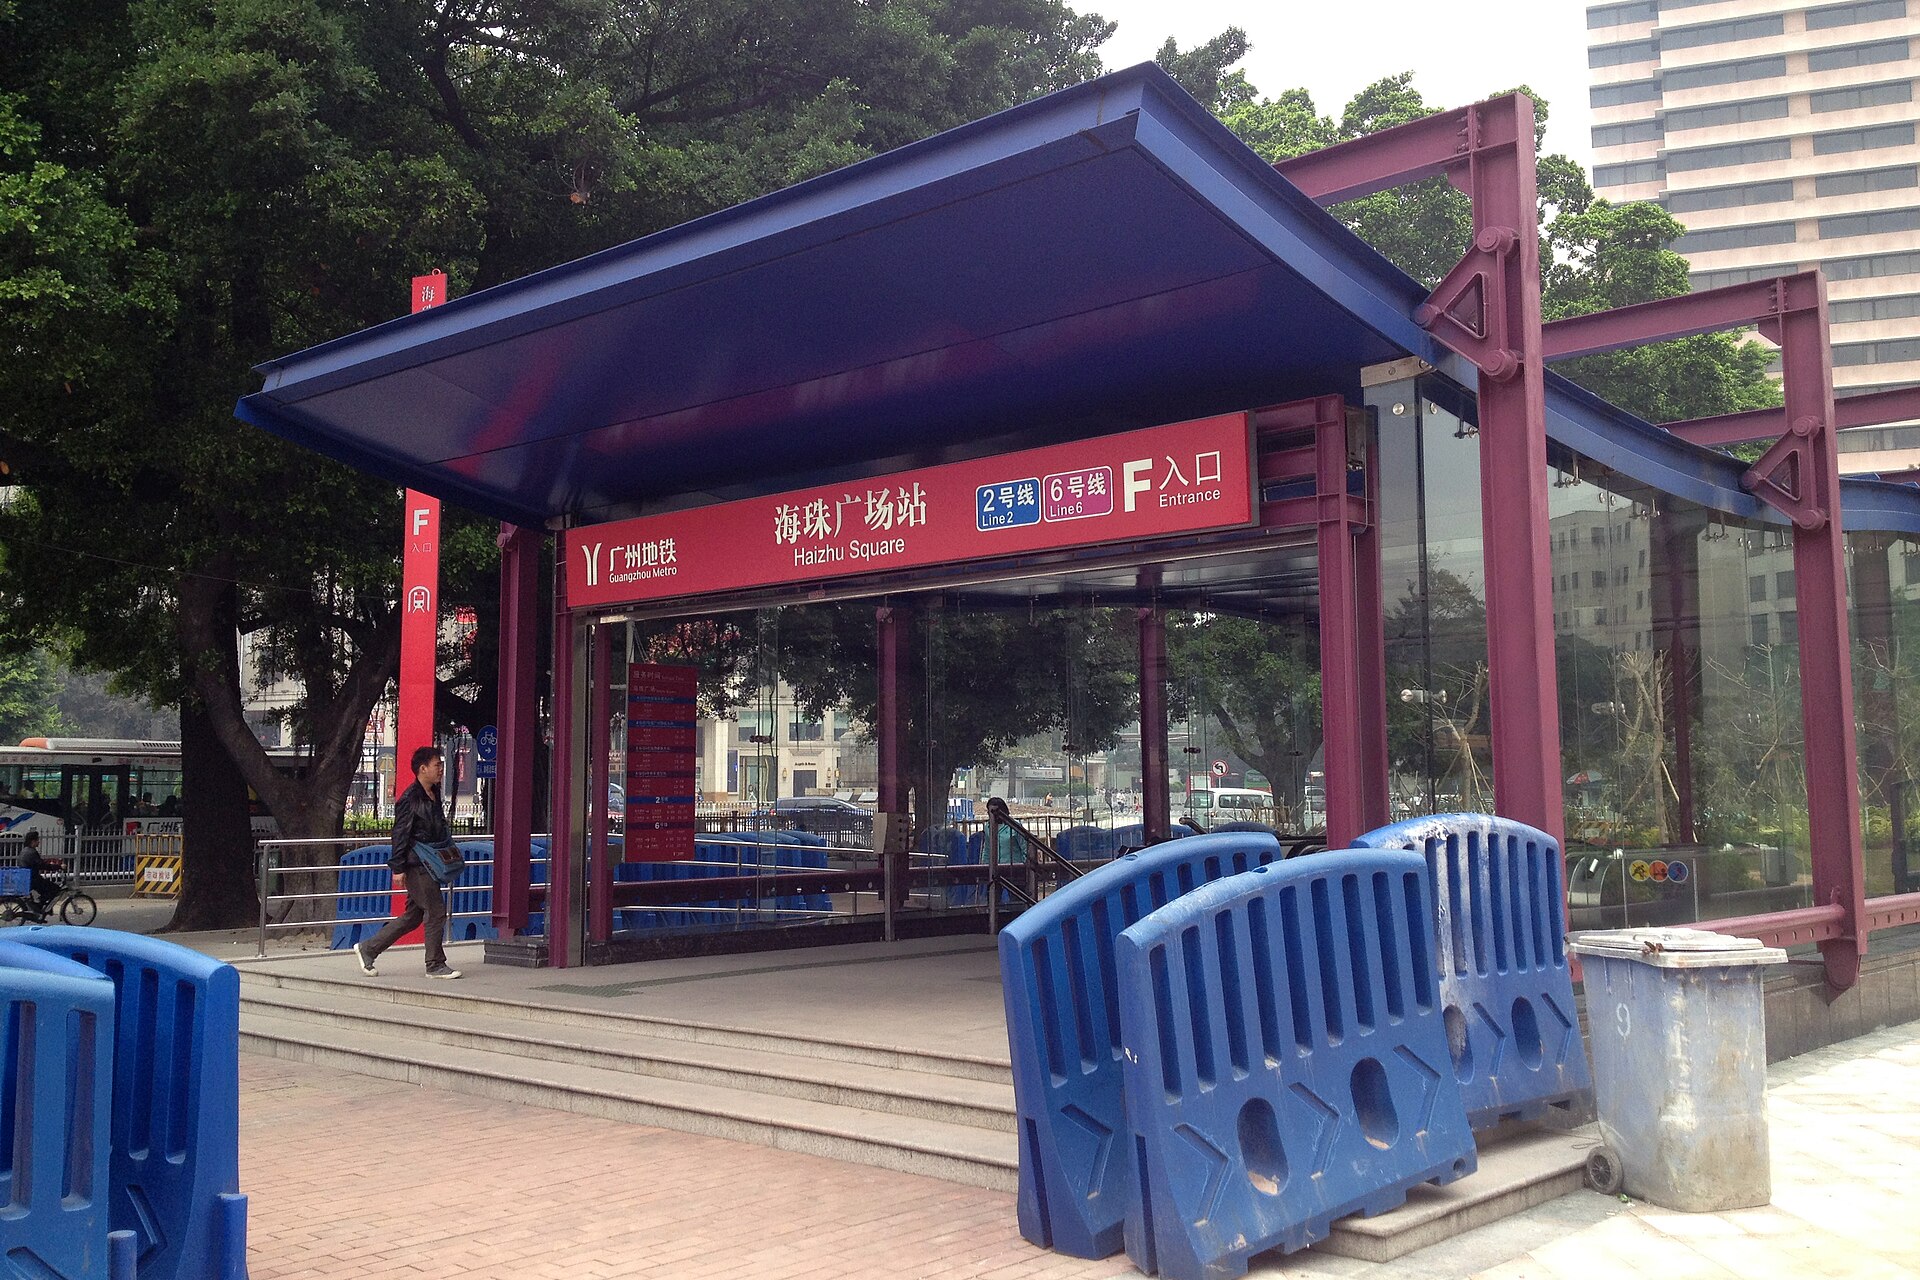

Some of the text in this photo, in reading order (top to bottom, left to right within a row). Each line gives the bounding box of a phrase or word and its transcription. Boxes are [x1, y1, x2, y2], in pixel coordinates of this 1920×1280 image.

[1123, 458, 1153, 513] F
[1158, 450, 1222, 491] 入口
[982, 482, 1035, 513] 2号线
[1049, 472, 1107, 502] 6号线
[1159, 488, 1222, 508] Entrance
[413, 508, 430, 536] F
[774, 482, 927, 545] 海珠广场站
[411, 542, 432, 553] 入口
[609, 537, 677, 572] 广州地铁
[794, 537, 905, 567] Haizhu Square
[609, 565, 678, 584] Guangzhou Metro
